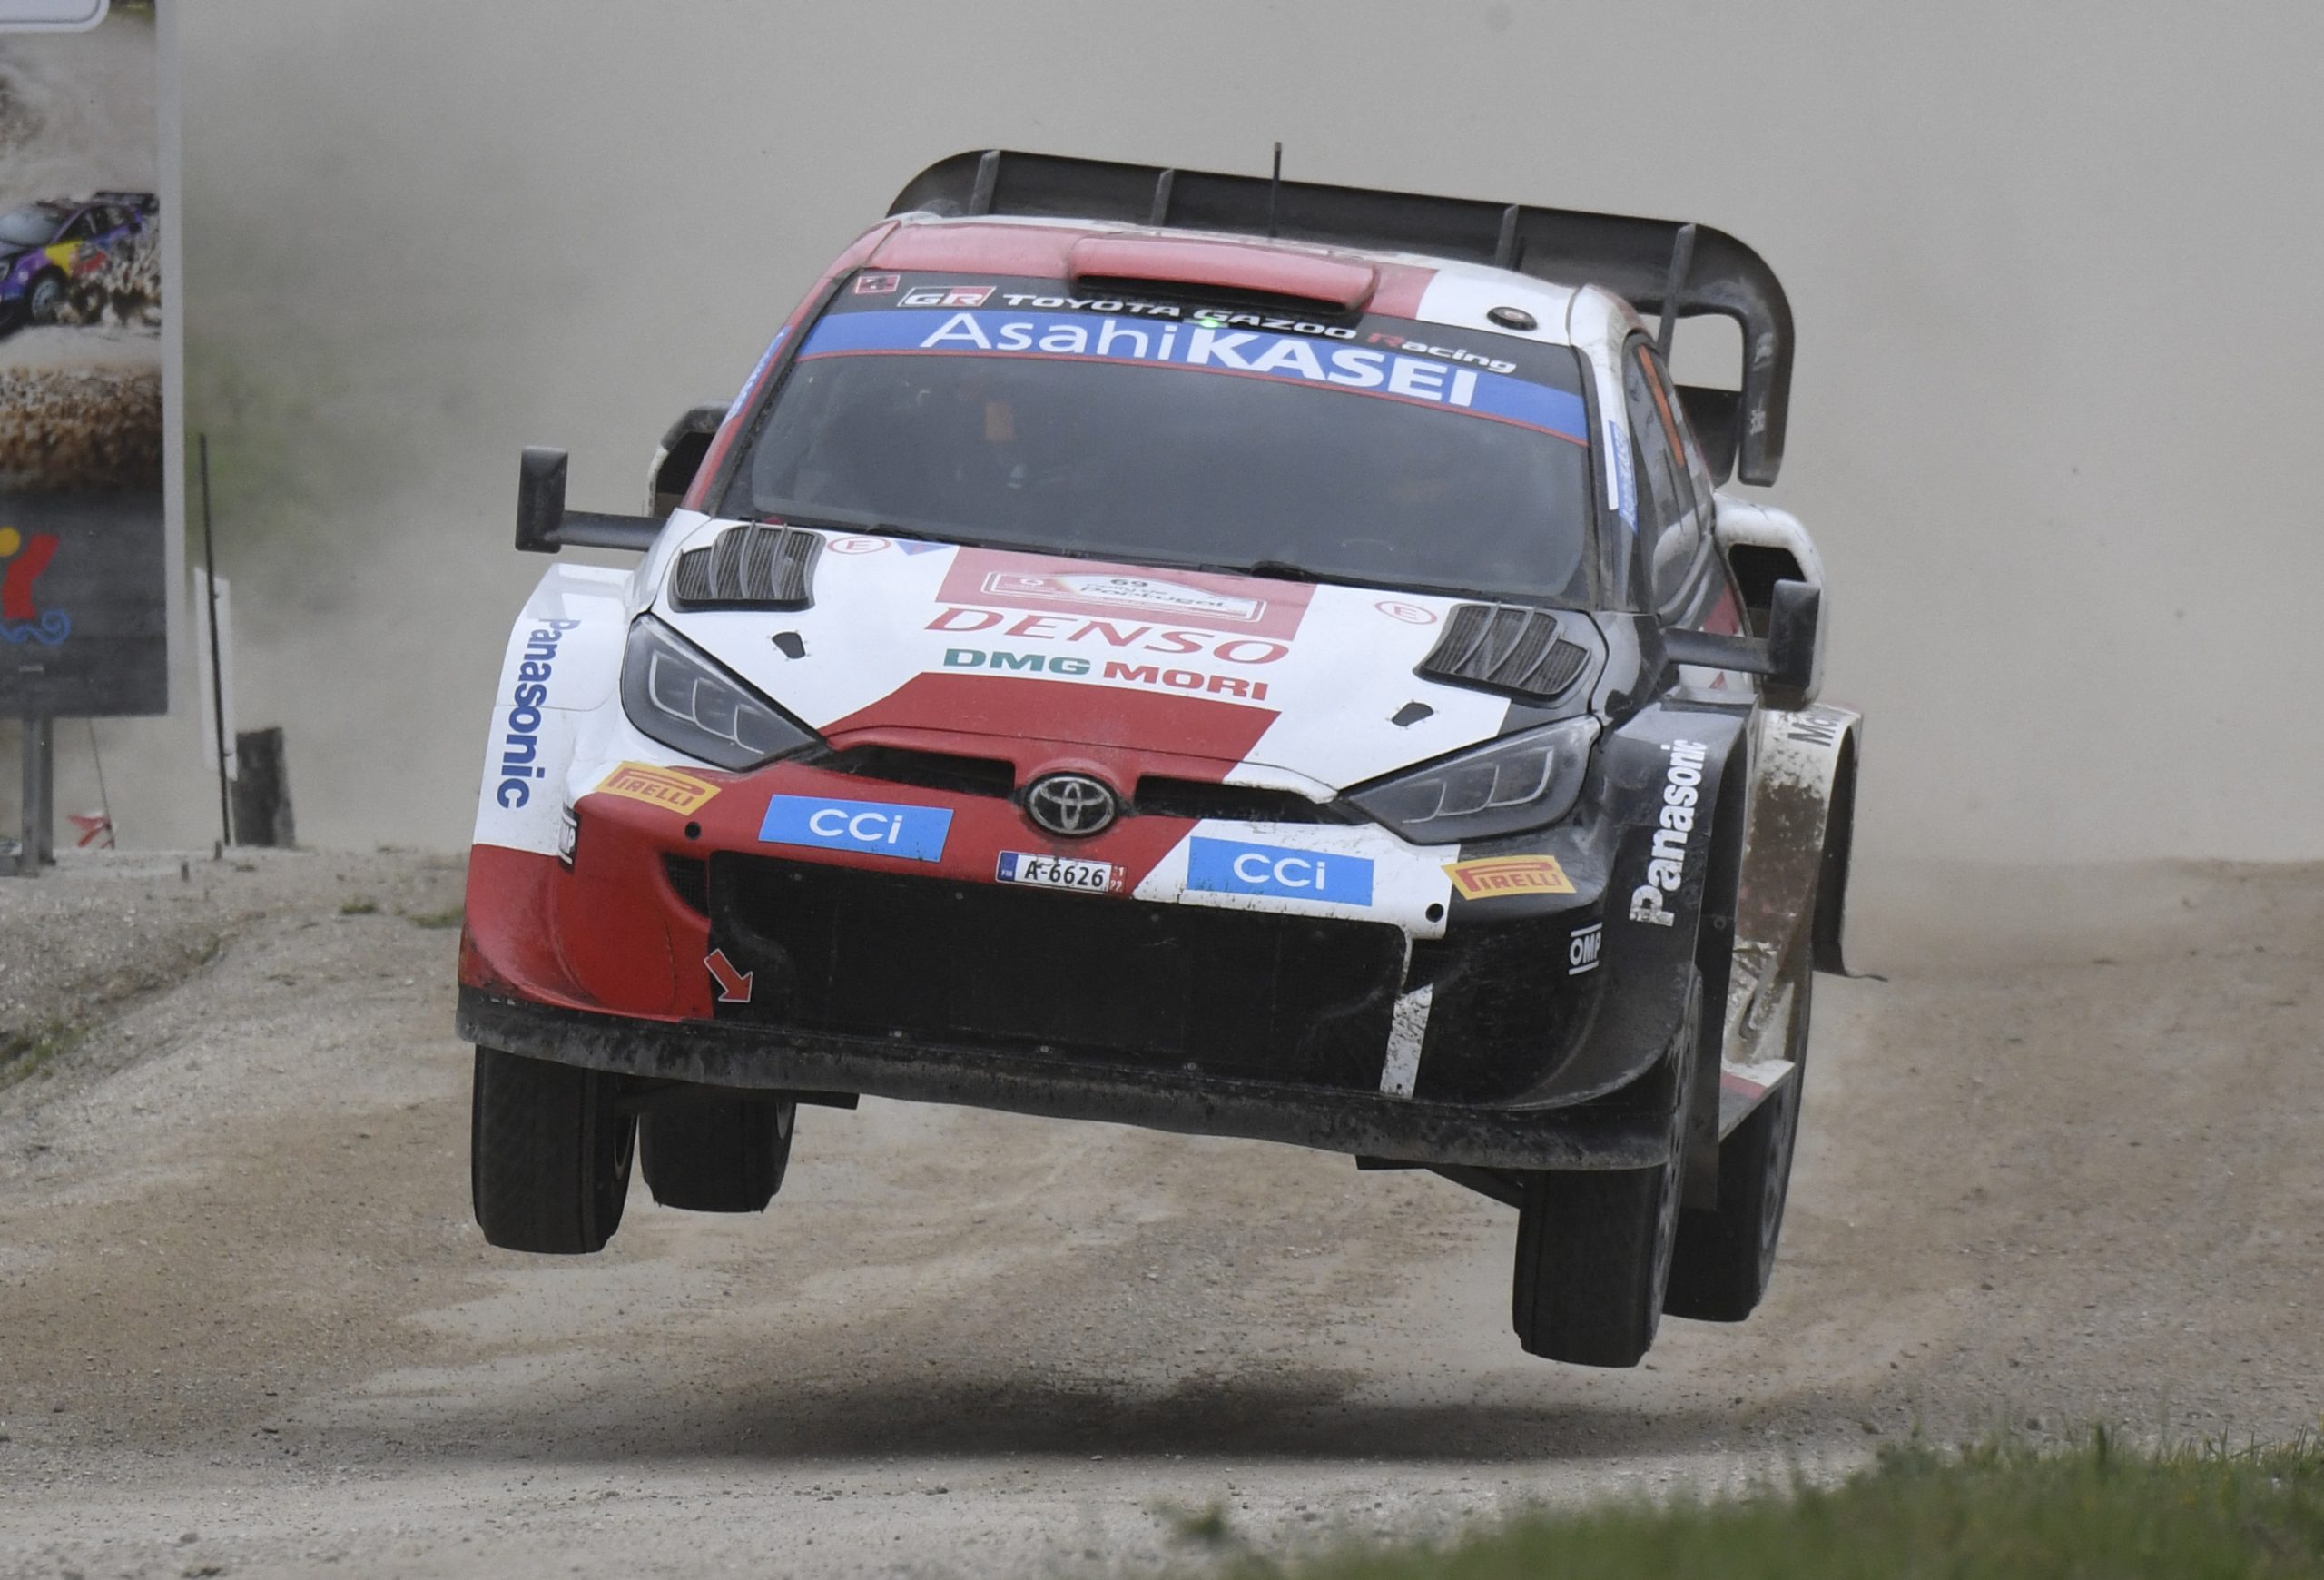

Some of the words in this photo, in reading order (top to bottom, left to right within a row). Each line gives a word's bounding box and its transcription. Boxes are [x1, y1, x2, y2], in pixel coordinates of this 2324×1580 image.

[904, 292, 984, 306] GR
[1002, 294, 1180, 317] TOYOTA
[1194, 309, 1357, 340] GAZOO
[1367, 332, 1517, 374] Racing
[919, 312, 1178, 360] Asahi
[1187, 328, 1478, 407] KASEI
[924, 607, 1290, 665] DENSO
[943, 647, 1091, 676] DMG
[1103, 661, 1269, 701] MORI
[497, 618, 581, 809] Panasonic
[605, 767, 706, 807] PIRELLI
[1630, 739, 1708, 927] Panasonic
[1024, 860, 1106, 888] A-6626
[1455, 861, 1562, 892] PIRELLI
[1570, 931, 1601, 965] OMP
